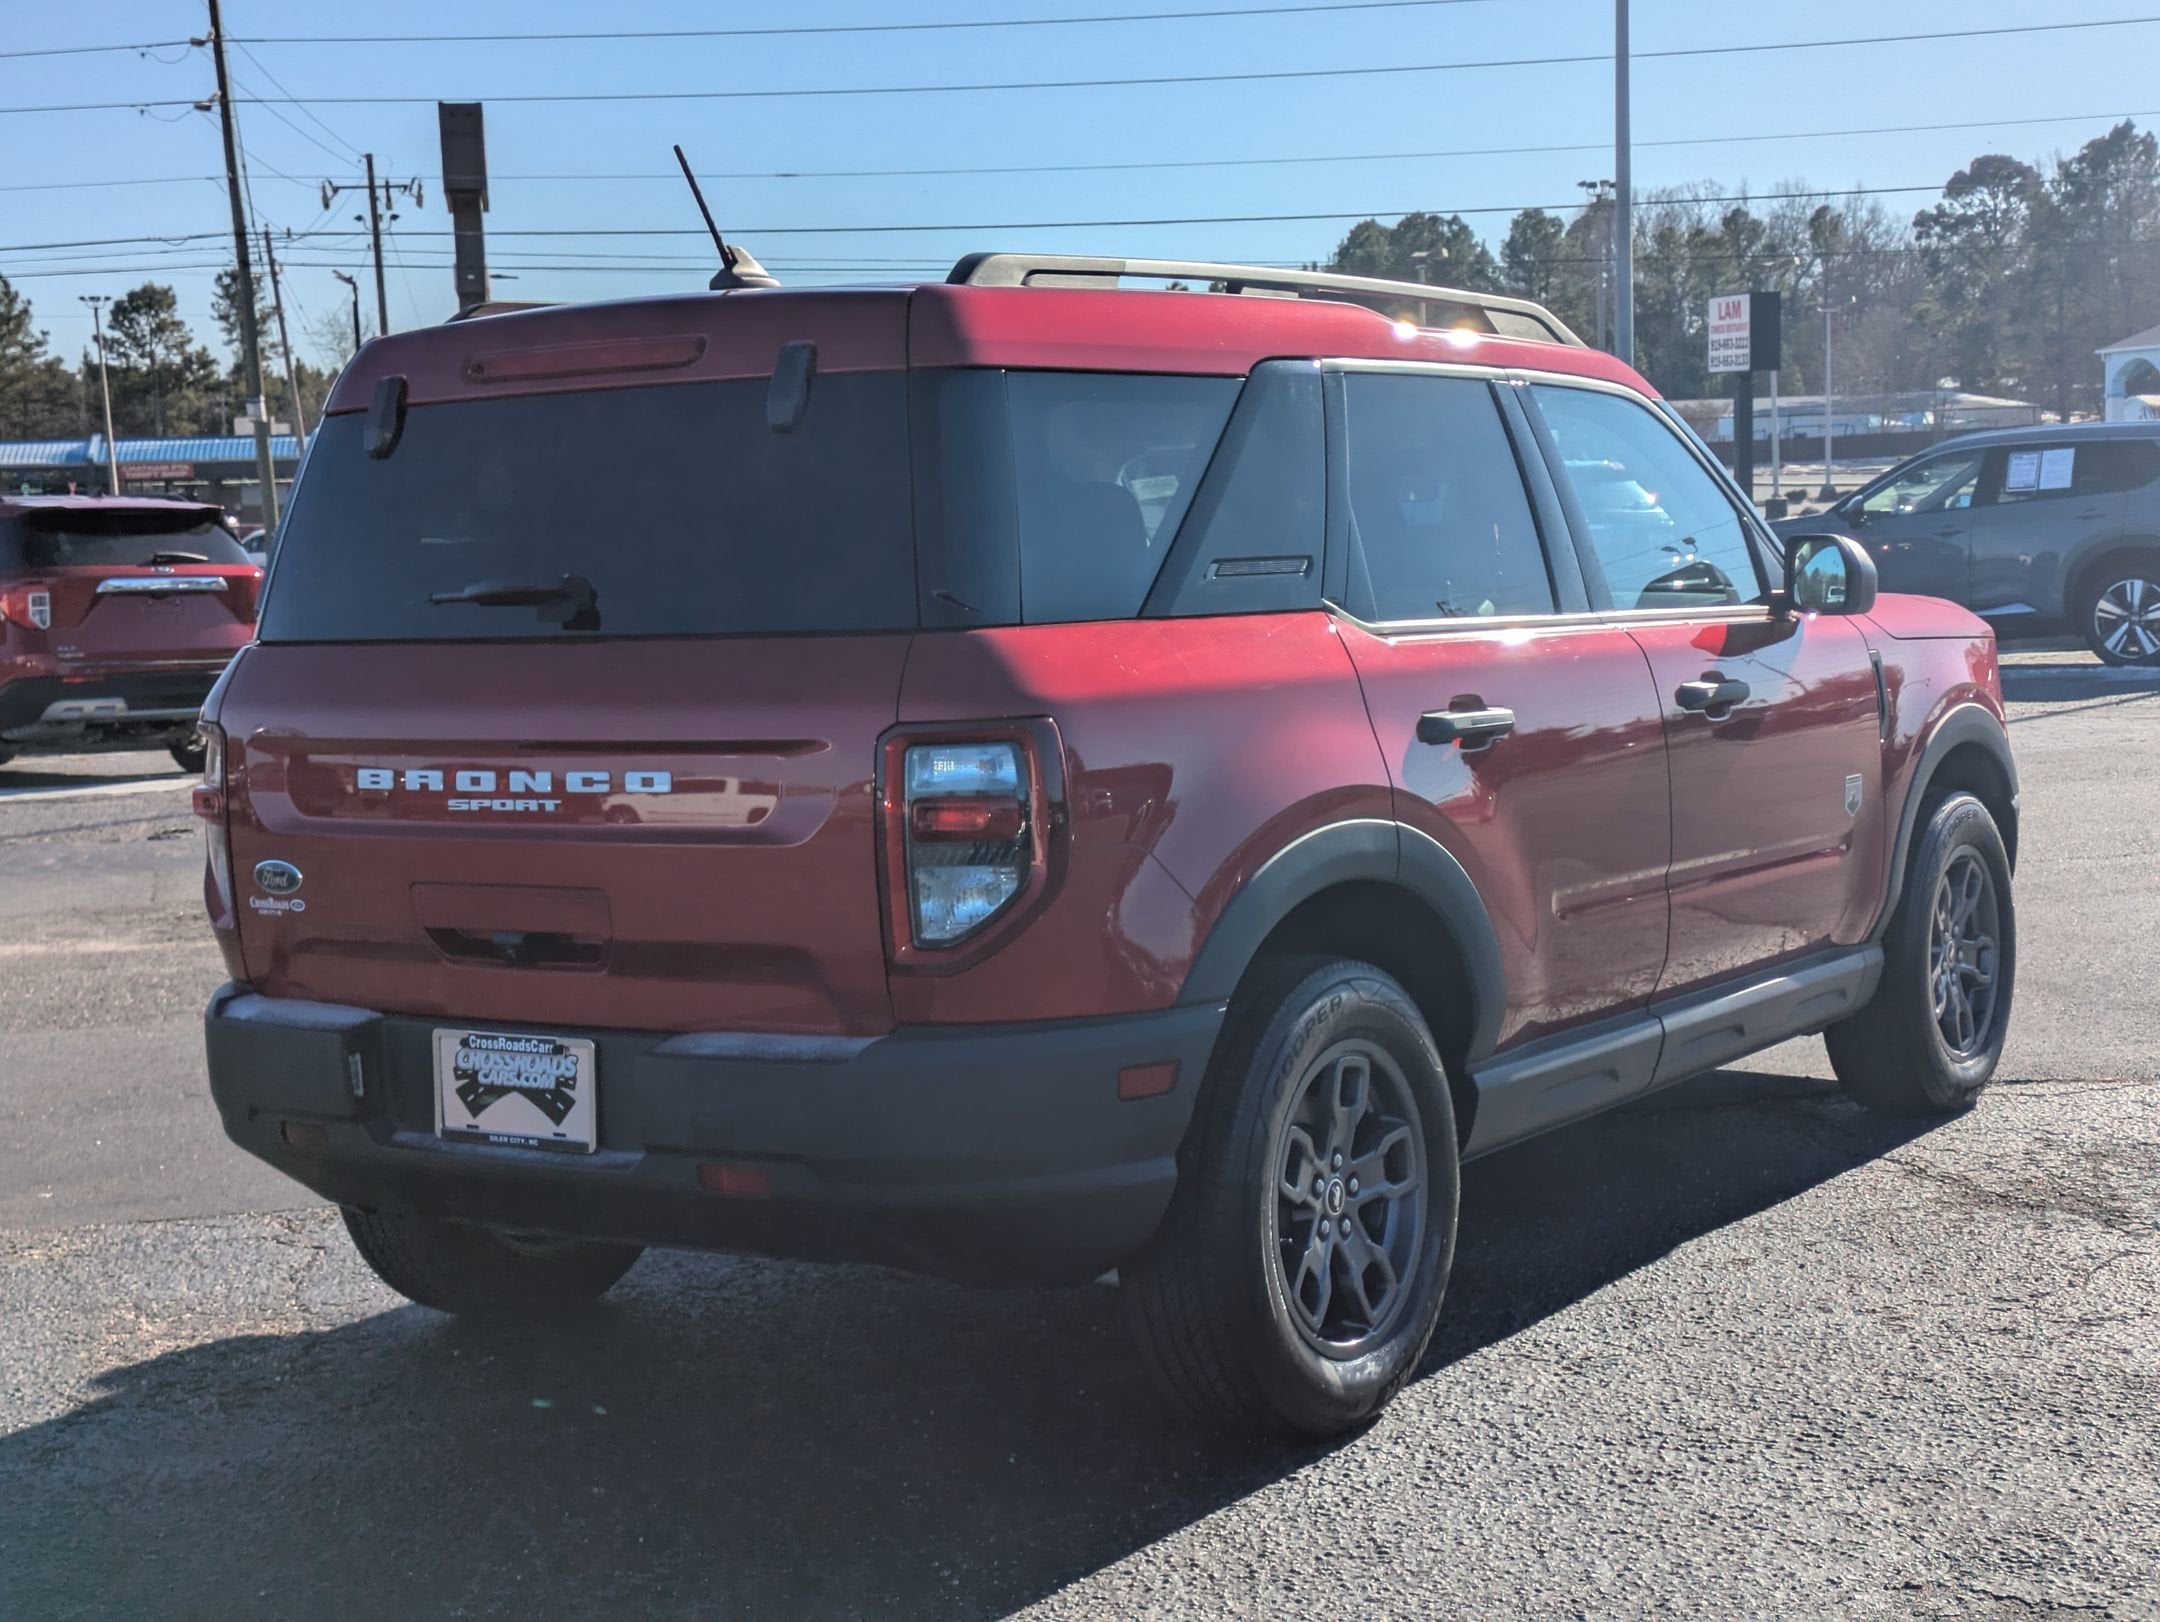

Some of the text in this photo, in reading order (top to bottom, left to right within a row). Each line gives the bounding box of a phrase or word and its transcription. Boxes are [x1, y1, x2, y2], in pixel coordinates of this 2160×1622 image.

[1718, 300, 1742, 320] LAM
[357, 768, 673, 794] BRONCO
[448, 799, 562, 812] SPORT
[1271, 993, 1344, 1103] COOPER
[456, 1049, 578, 1078] CROSSROADS
[478, 1069, 556, 1089] CARS.COM
